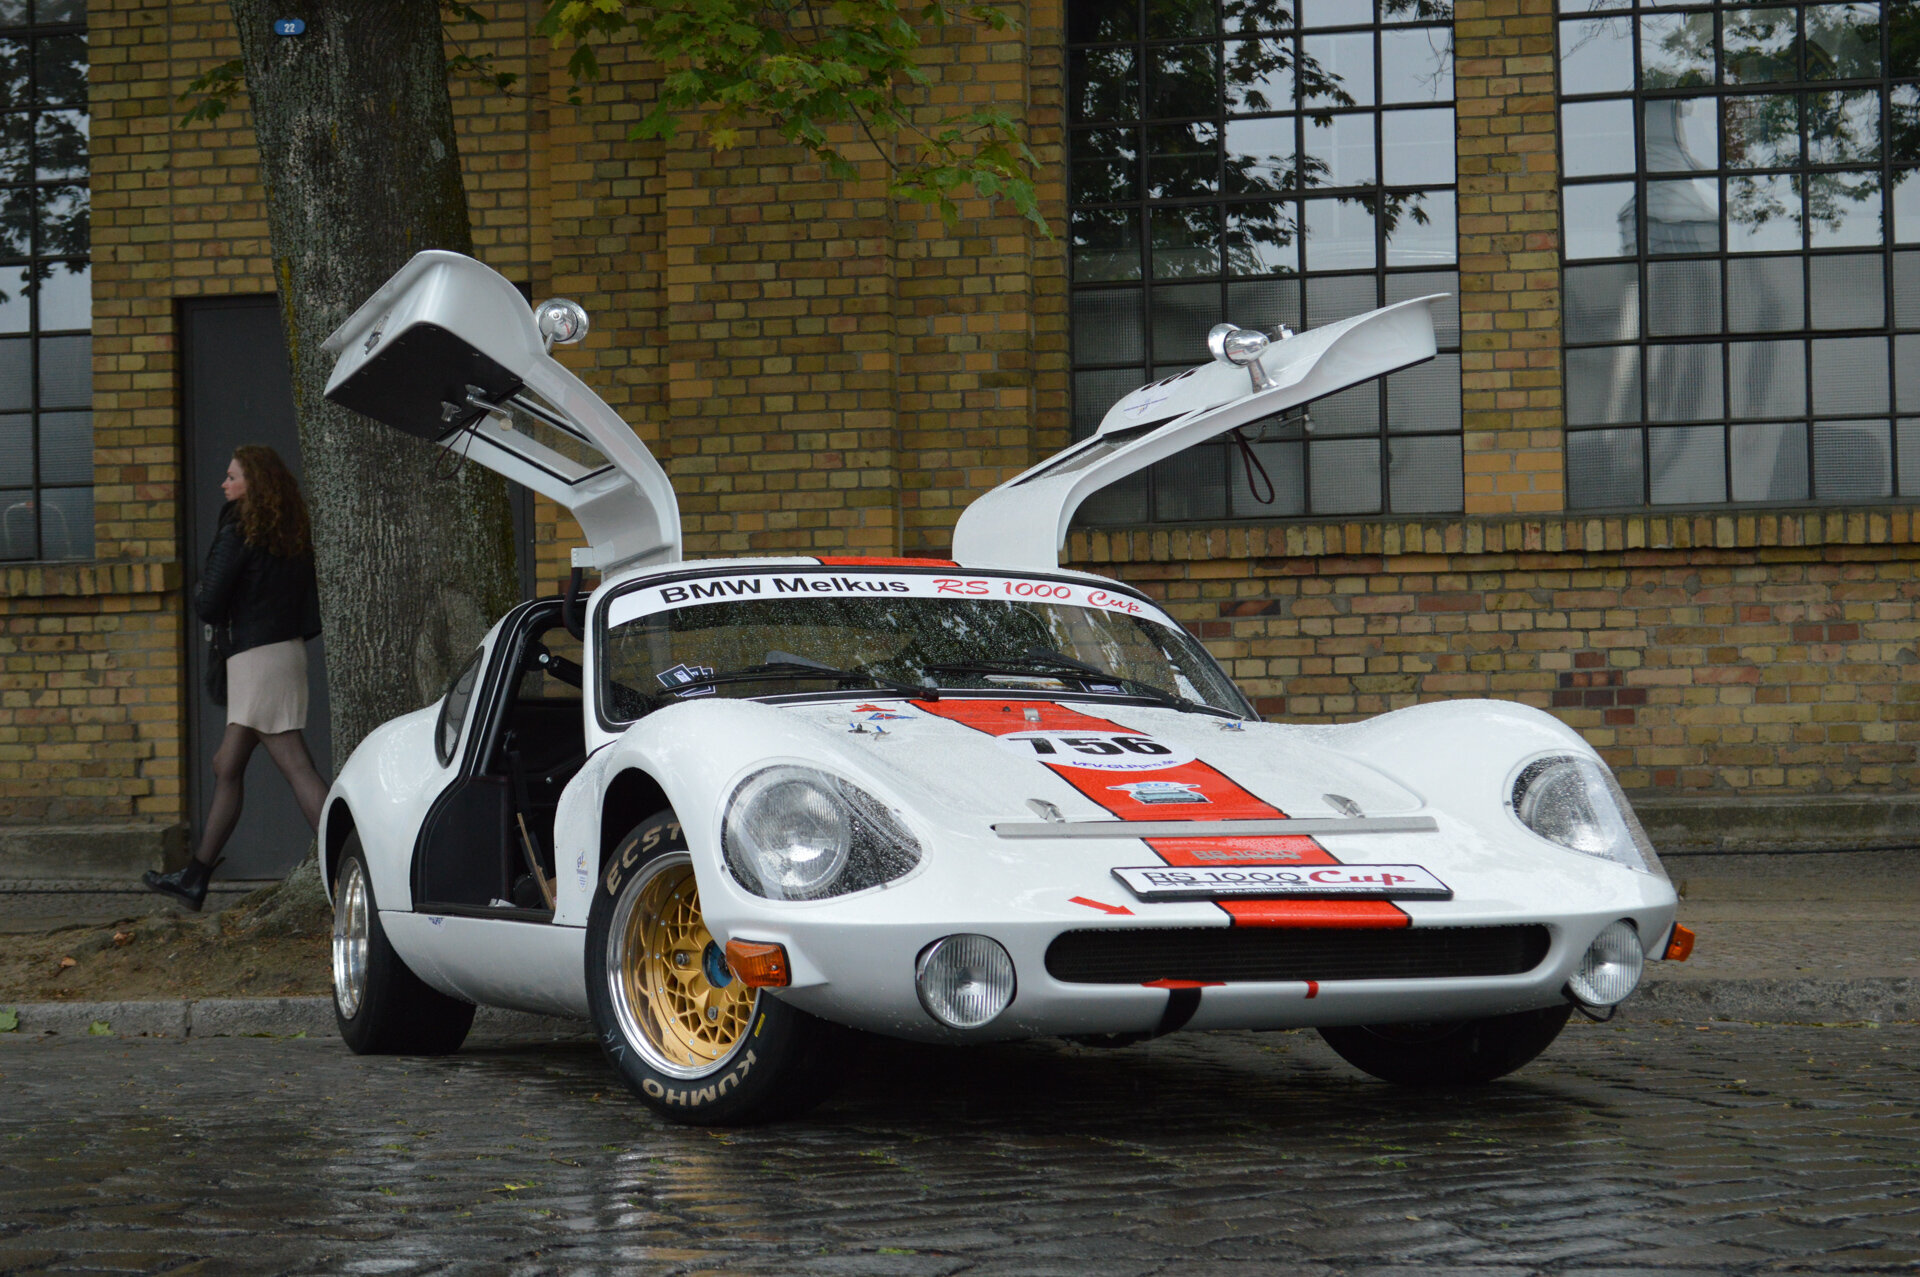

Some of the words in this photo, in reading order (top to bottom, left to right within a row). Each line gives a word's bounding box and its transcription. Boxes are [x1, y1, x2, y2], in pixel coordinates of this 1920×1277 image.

[284, 23, 295, 33] 22
[659, 578, 761, 604] BMW
[772, 577, 910, 593] Melkus
[932, 579, 990, 595] RS
[1002, 581, 1071, 599] 1000
[1087, 590, 1144, 613] Cup
[1232, 850, 1299, 858] 1000
[1142, 872, 1197, 882] RS
[1204, 872, 1301, 883] 1000
[1309, 870, 1416, 886] Cup
[642, 1049, 757, 1106] KUMHO
